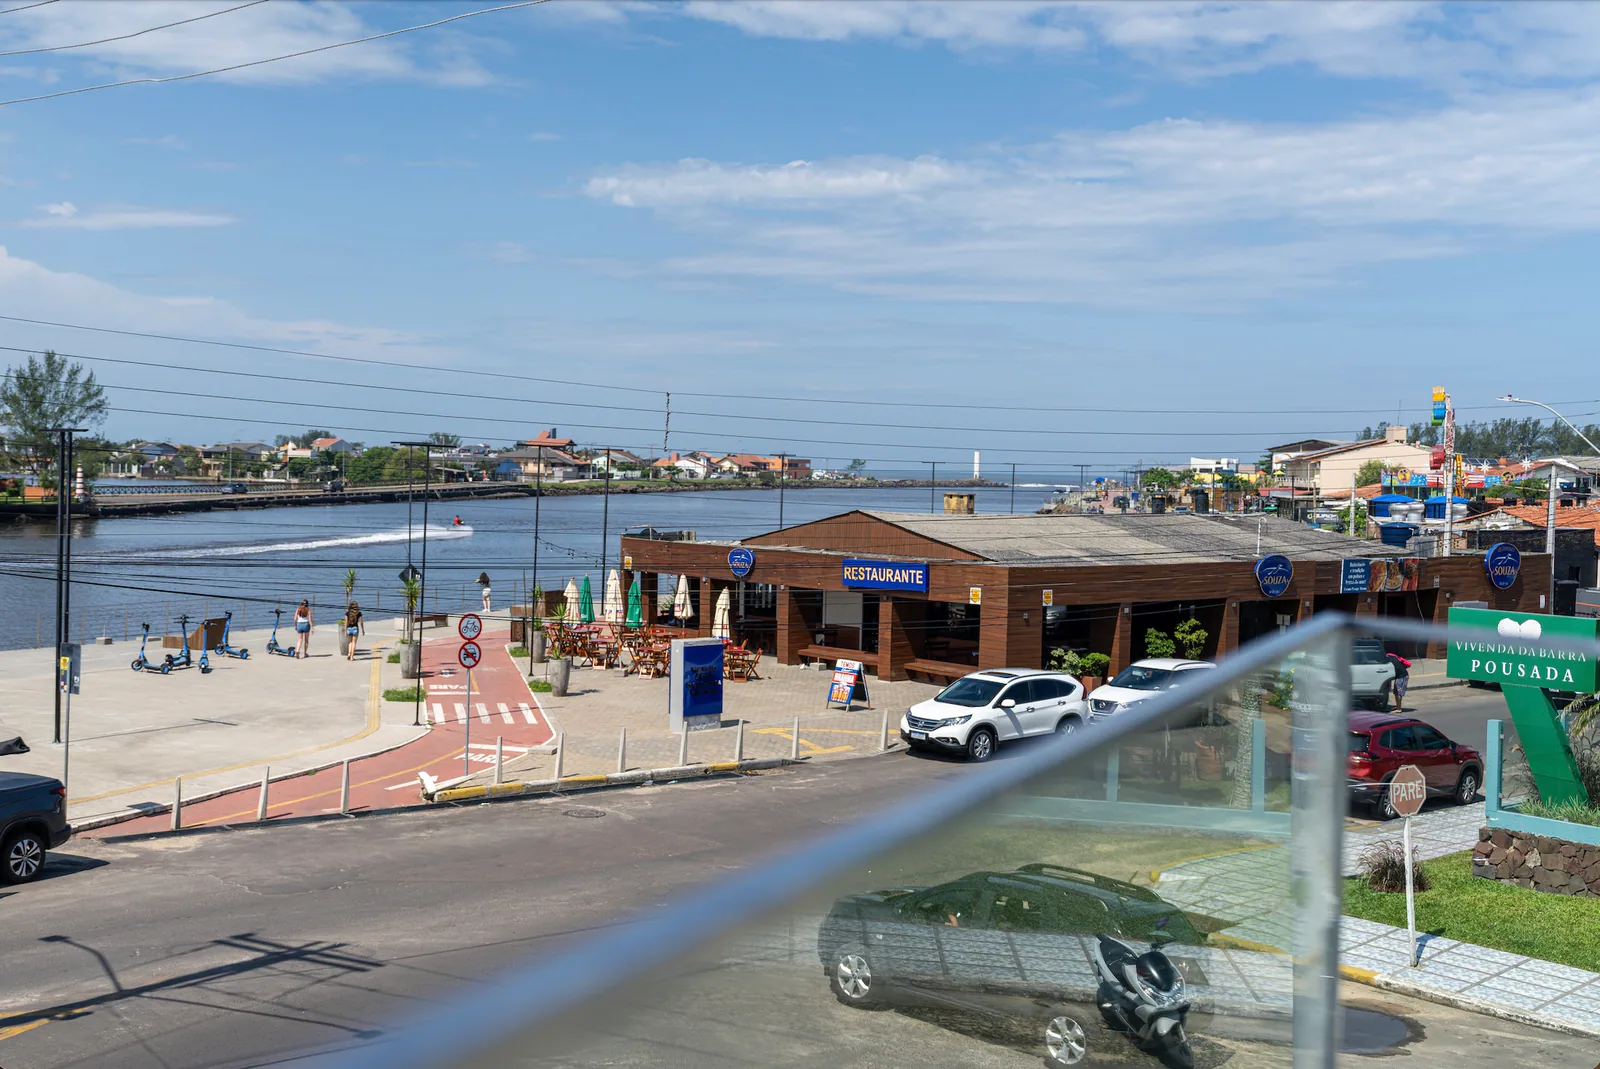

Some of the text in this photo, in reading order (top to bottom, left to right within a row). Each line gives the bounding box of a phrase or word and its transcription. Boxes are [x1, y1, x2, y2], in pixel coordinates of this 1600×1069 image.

[843, 566, 924, 585] RESTAURANTE
[1263, 576, 1287, 585] SOUZA
[1494, 565, 1516, 576] SOUZA
[1456, 641, 1586, 662] VIVENDA DA BARRA
[1471, 659, 1574, 683] POUSADA
[1393, 780, 1423, 803] PARE
